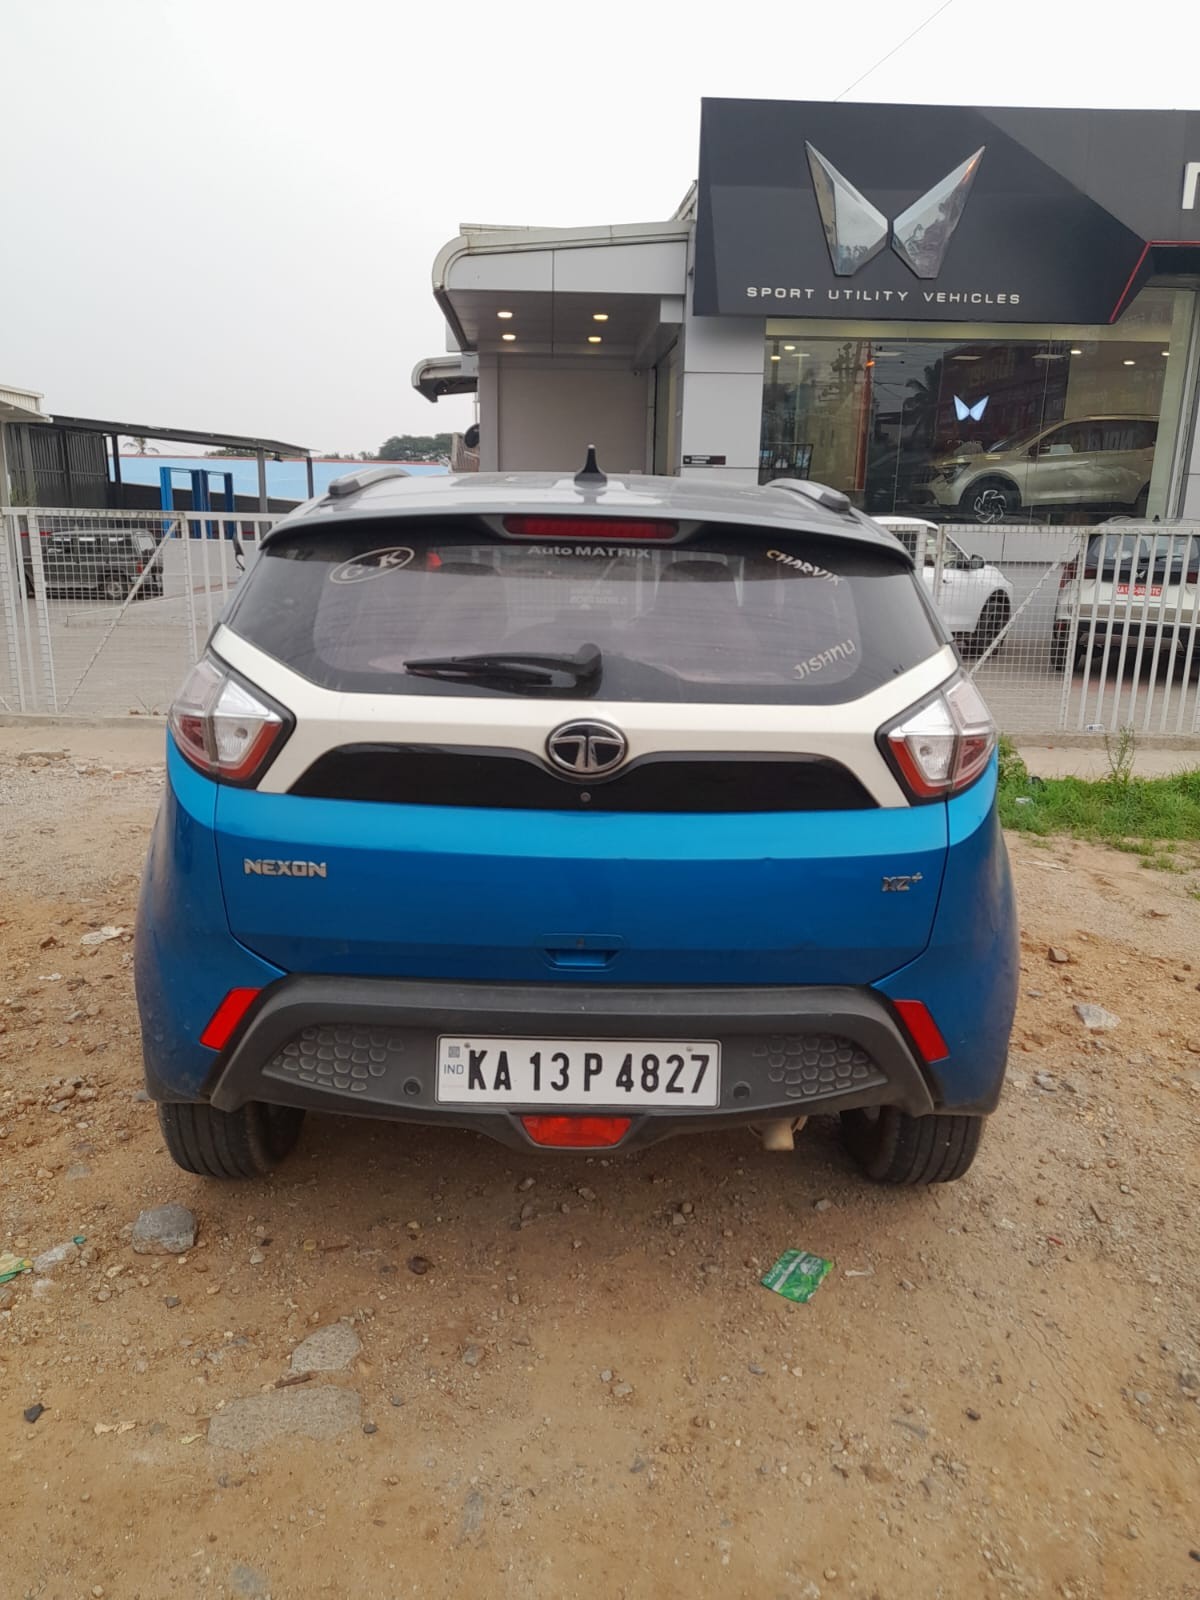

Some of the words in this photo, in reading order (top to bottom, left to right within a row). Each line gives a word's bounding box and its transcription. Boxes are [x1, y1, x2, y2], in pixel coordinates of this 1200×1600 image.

[746, 287, 815, 300] SPORT
[828, 290, 909, 302] UTILITY
[923, 292, 1021, 305] VEHICLES
[244, 858, 327, 877] NEXON
[443, 1064, 465, 1075] IND
[468, 1050, 512, 1090] KA
[529, 1052, 570, 1091] 13
[584, 1053, 603, 1092] P
[615, 1053, 710, 1093] 4827
